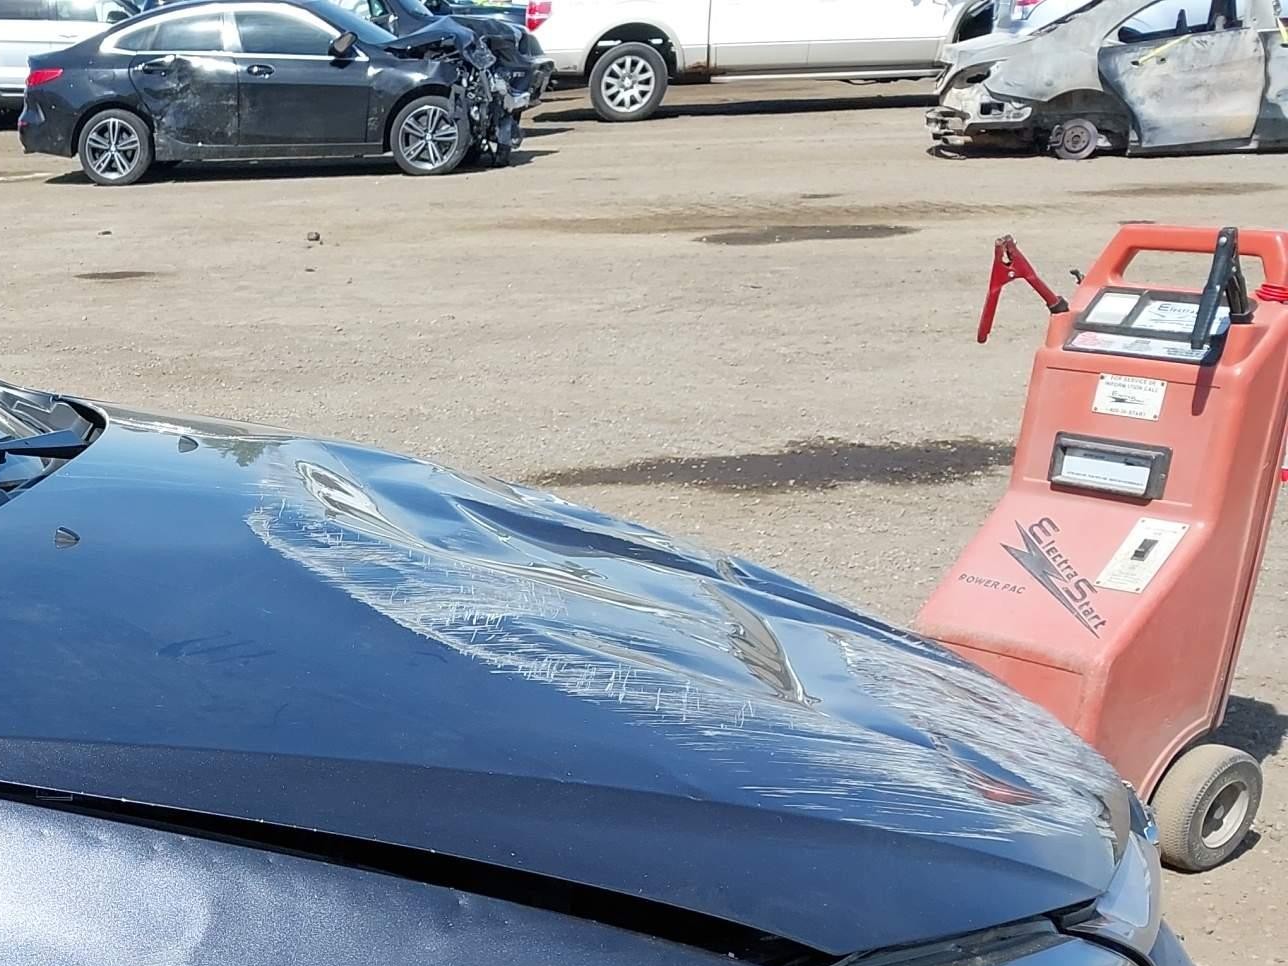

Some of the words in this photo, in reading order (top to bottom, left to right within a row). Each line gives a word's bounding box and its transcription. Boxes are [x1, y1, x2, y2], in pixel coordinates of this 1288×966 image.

[958, 573, 1000, 589] POWER
[1001, 583, 1026, 594] PAC
[1028, 517, 1078, 581] Electra
[1062, 577, 1107, 630] Start
